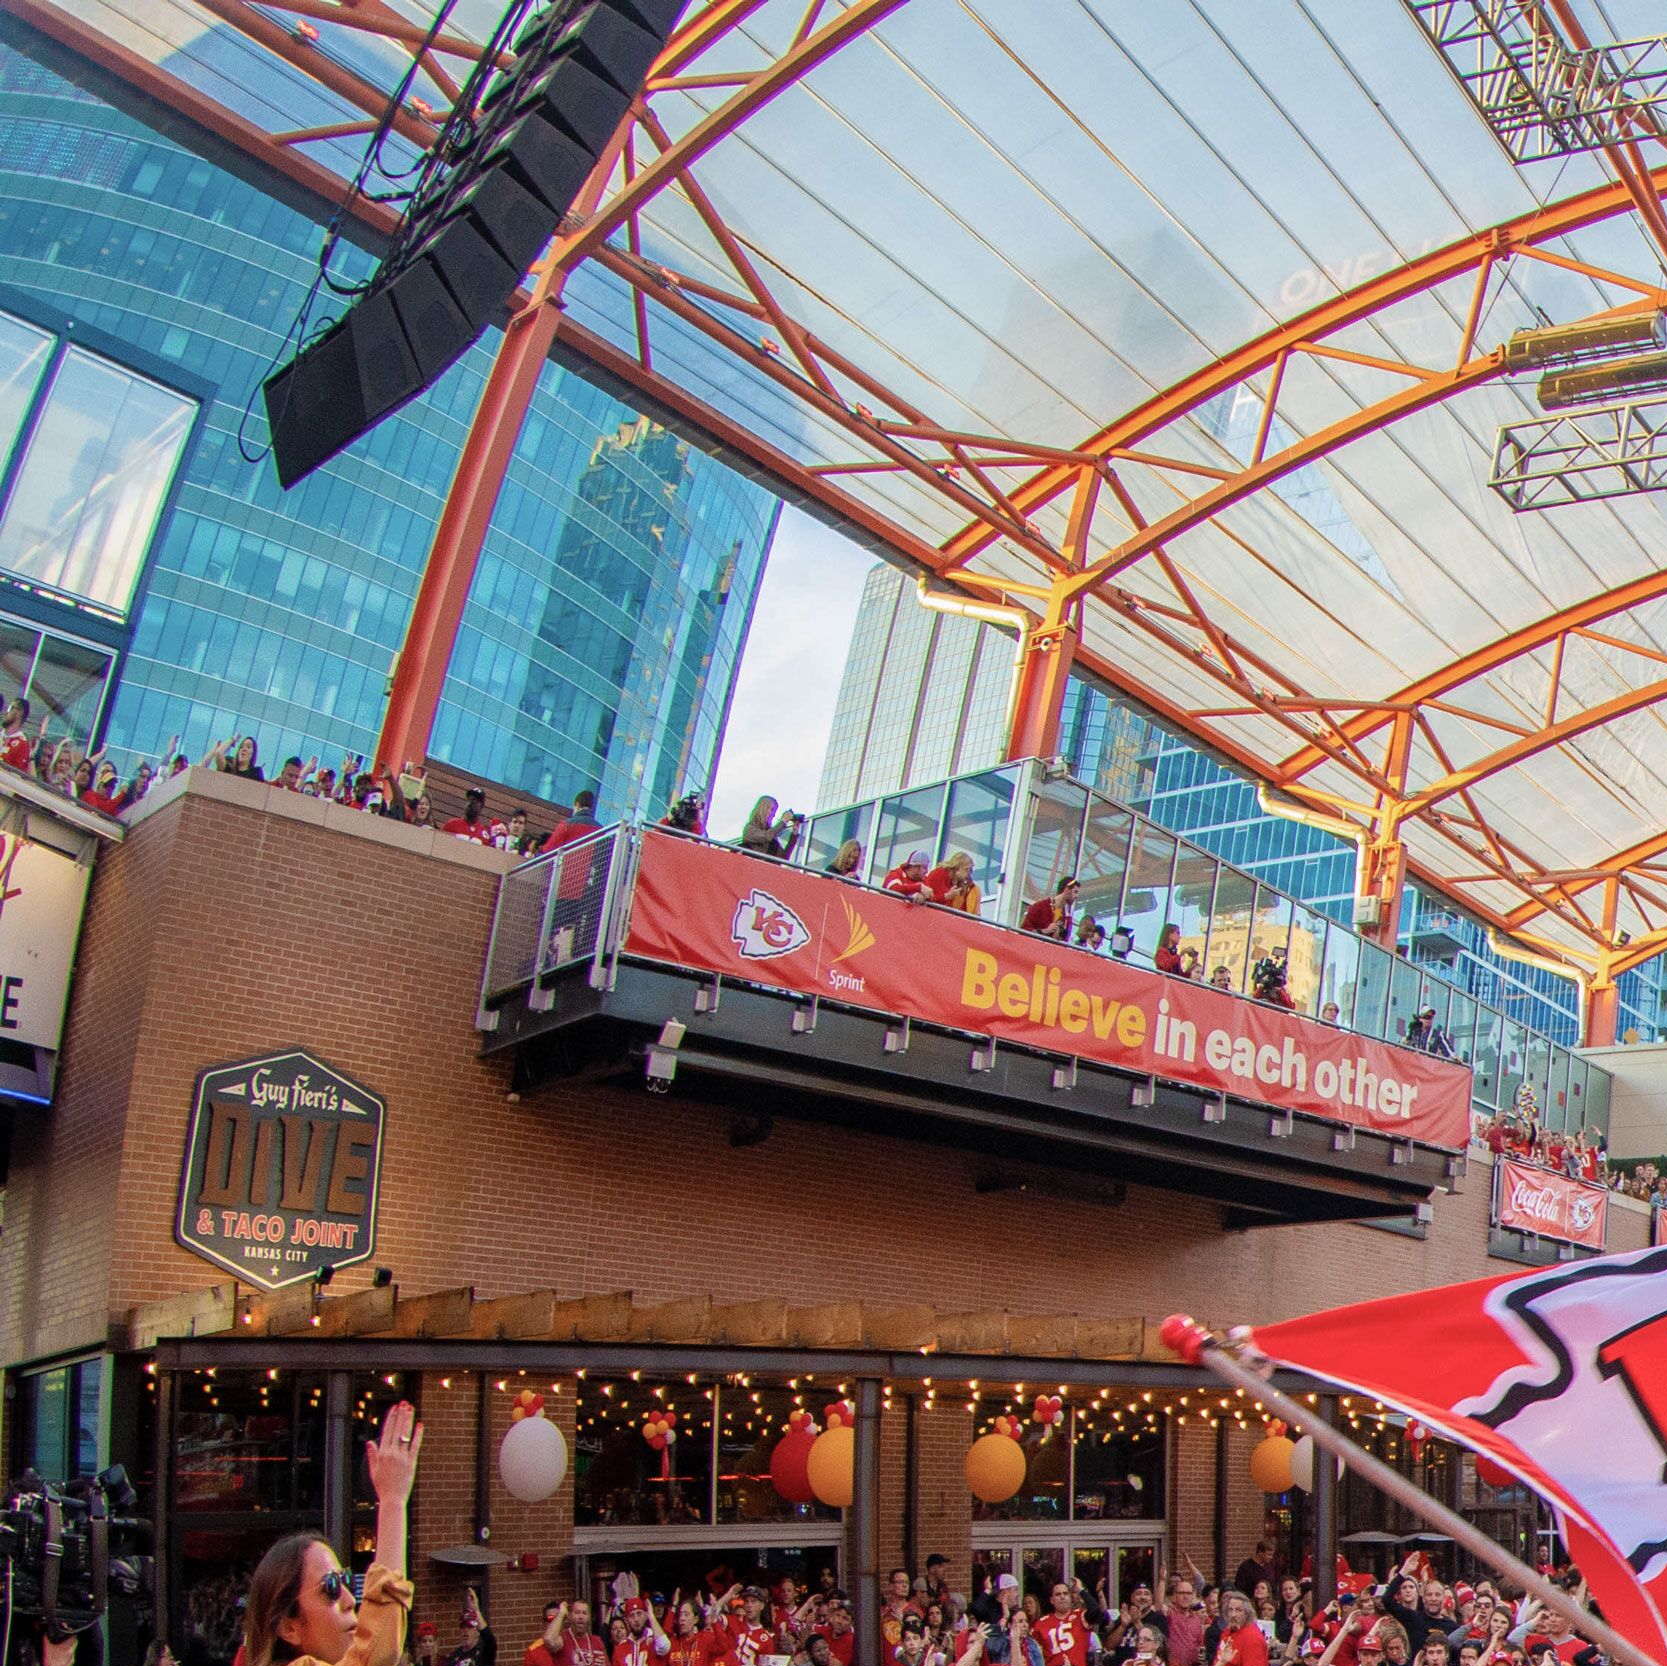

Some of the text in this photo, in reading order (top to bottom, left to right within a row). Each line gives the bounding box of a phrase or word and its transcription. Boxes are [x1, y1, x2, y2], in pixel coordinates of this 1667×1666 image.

[828, 969, 866, 993] Sprint
[960, 947, 1419, 1119] Believe in each other
[251, 1068, 290, 1109] Guy
[196, 1102, 377, 1216] DIVE
[197, 1208, 358, 1249] & TACO JOINT
[244, 1246, 308, 1262] KANSAS CITY
